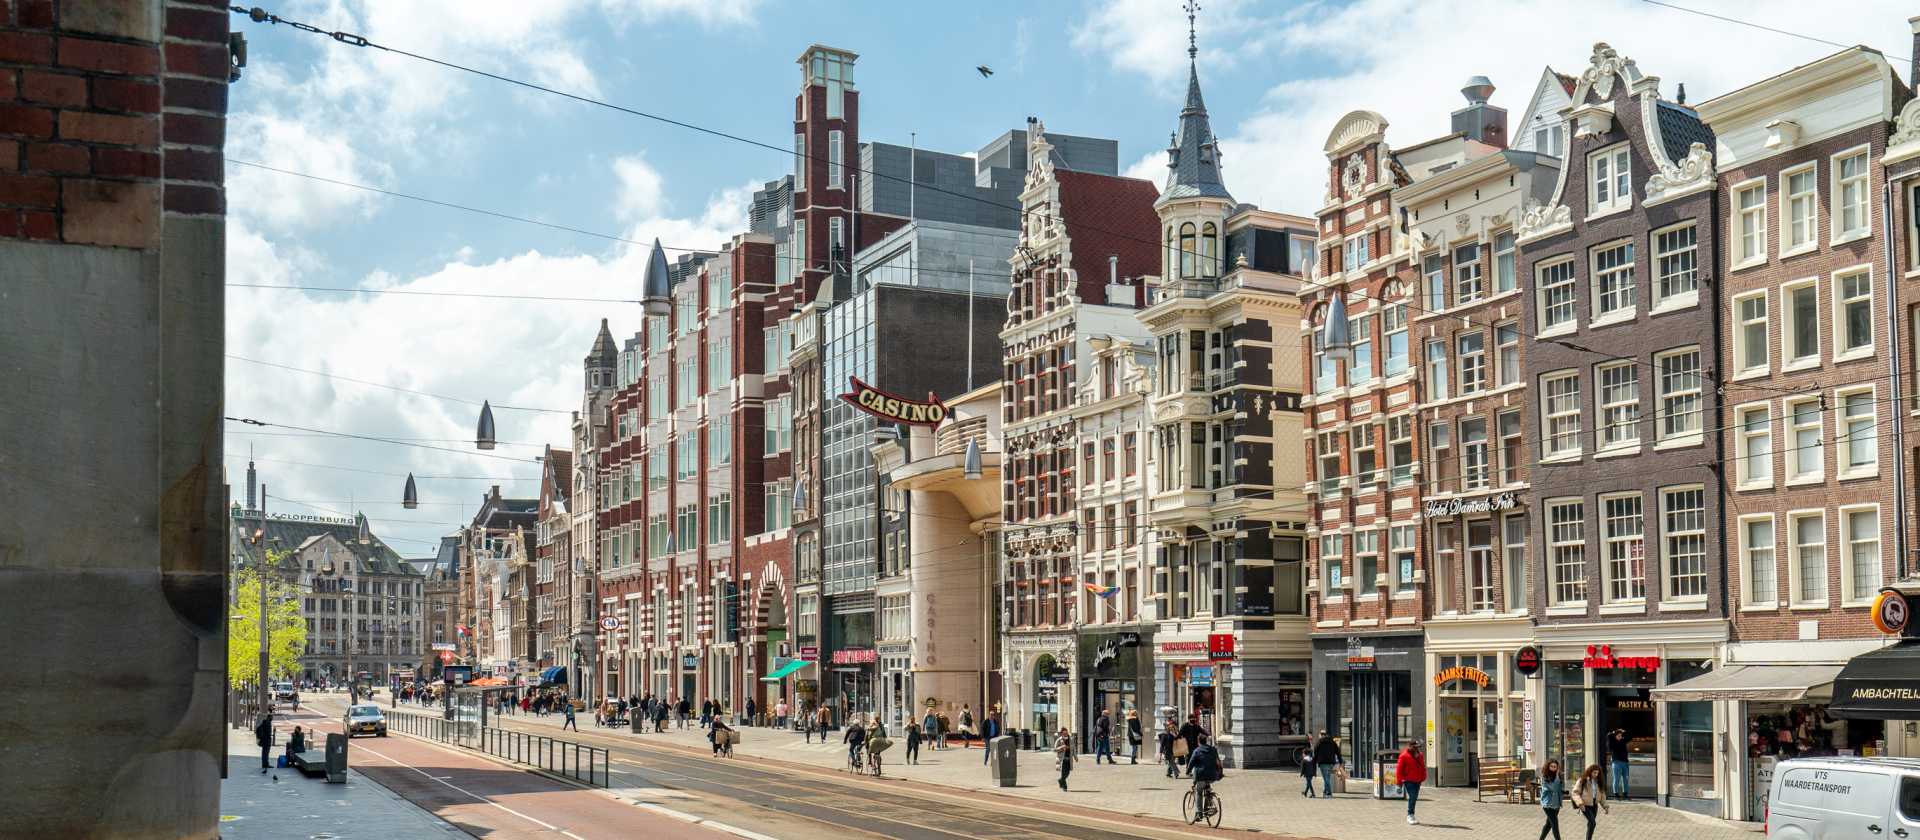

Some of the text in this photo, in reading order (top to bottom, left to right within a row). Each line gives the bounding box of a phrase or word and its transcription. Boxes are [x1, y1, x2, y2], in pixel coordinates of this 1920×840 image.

[858, 388, 943, 422] CASINO
[1424, 494, 1515, 518] Hotel Damrak Inn
[281, 513, 354, 524] CLOPPENBURG
[926, 593, 937, 666] CASINO
[1433, 666, 1489, 687] VLAAMSE FRITES
[1618, 700, 1642, 708] PASTRY
[1814, 771, 1829, 780] VTS
[1784, 779, 1851, 794] WAARDETRANSPORT
